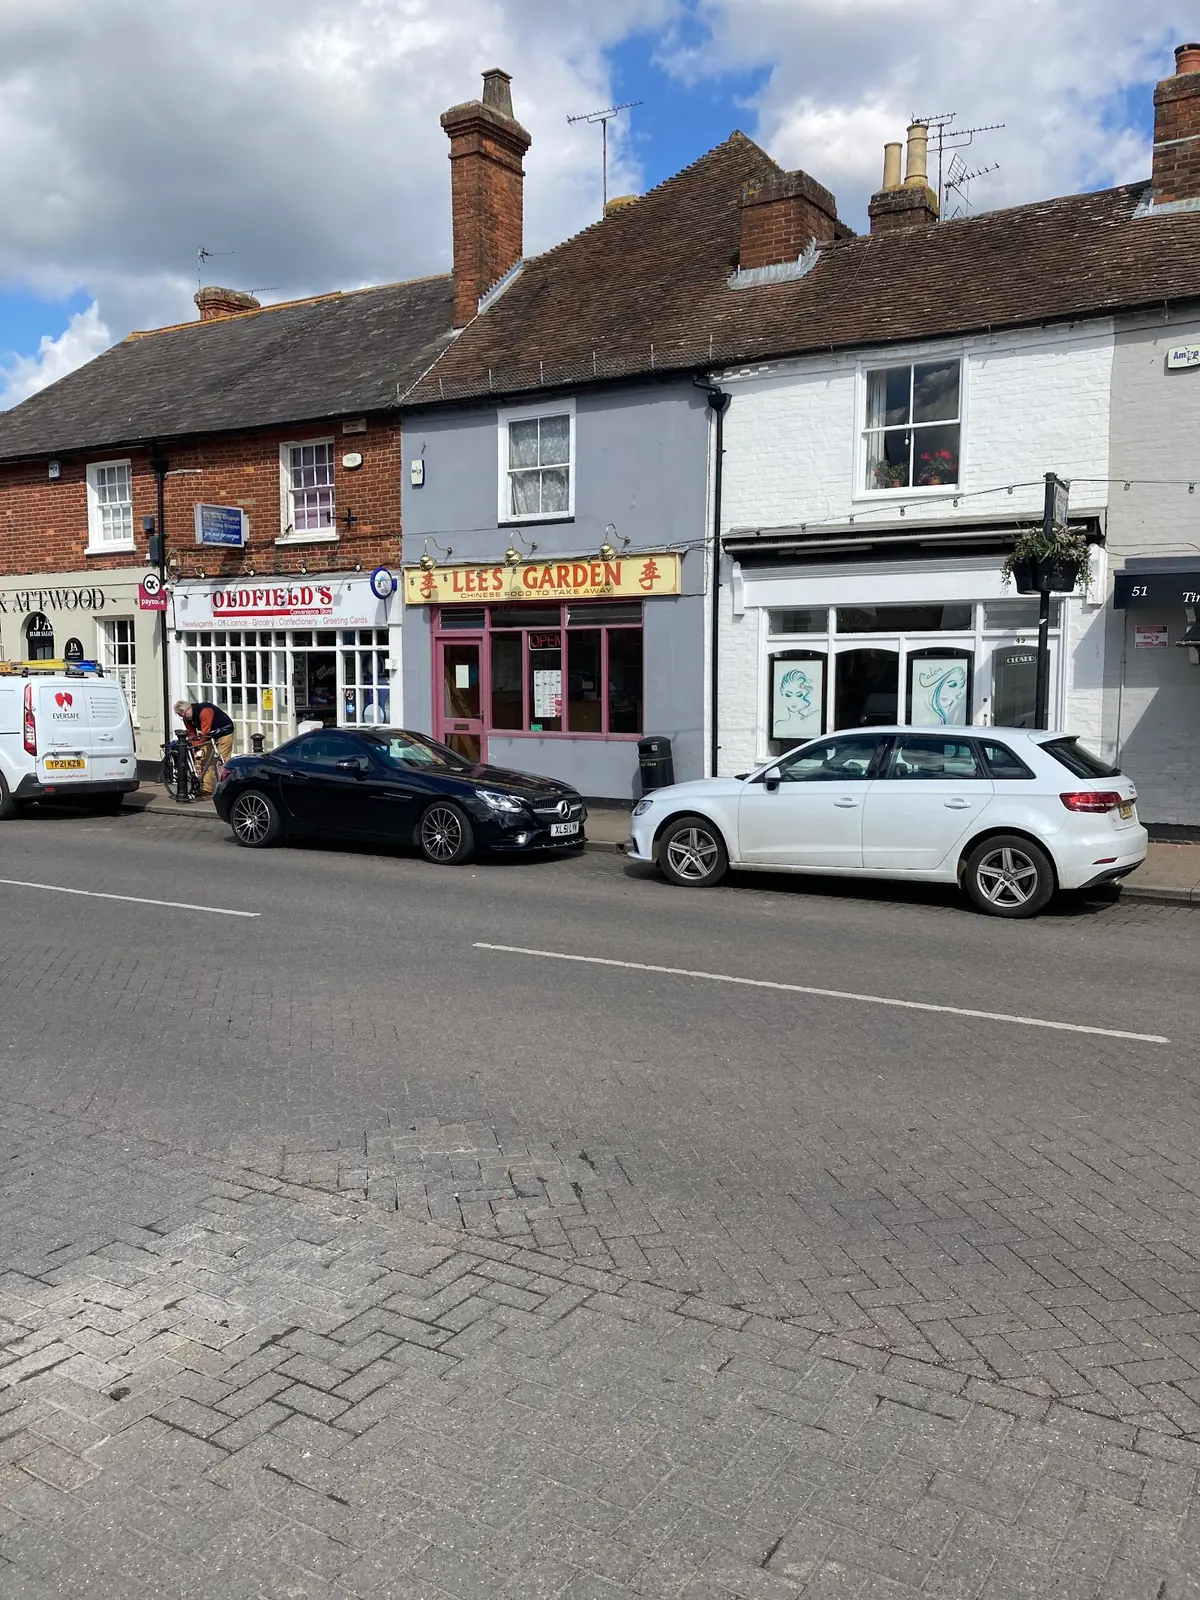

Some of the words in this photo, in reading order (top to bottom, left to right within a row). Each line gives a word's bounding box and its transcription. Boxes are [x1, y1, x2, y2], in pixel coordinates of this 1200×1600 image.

[453, 568, 503, 592] LEES
[523, 562, 622, 589] GARDEN
[212, 586, 333, 608] OLDFIELD'S
[460, 591, 501, 599] CHINESE
[504, 590, 532, 598] FOOD
[536, 589, 550, 597] TO
[553, 587, 580, 596] TAKE
[1131, 586, 1148, 597] 51
[12, 588, 105, 613] ATTWOOD
[289, 608, 319, 616] Convenience
[319, 607, 333, 615] Store
[182, 620, 213, 629] Newsagents
[218, 619, 248, 627] Off-Licence
[252, 619, 275, 628] Grocery
[279, 617, 318, 627] Confectionery
[322, 616, 348, 626] Greeting
[349, 615, 368, 625] Cards
[531, 633, 561, 647] OPEN
